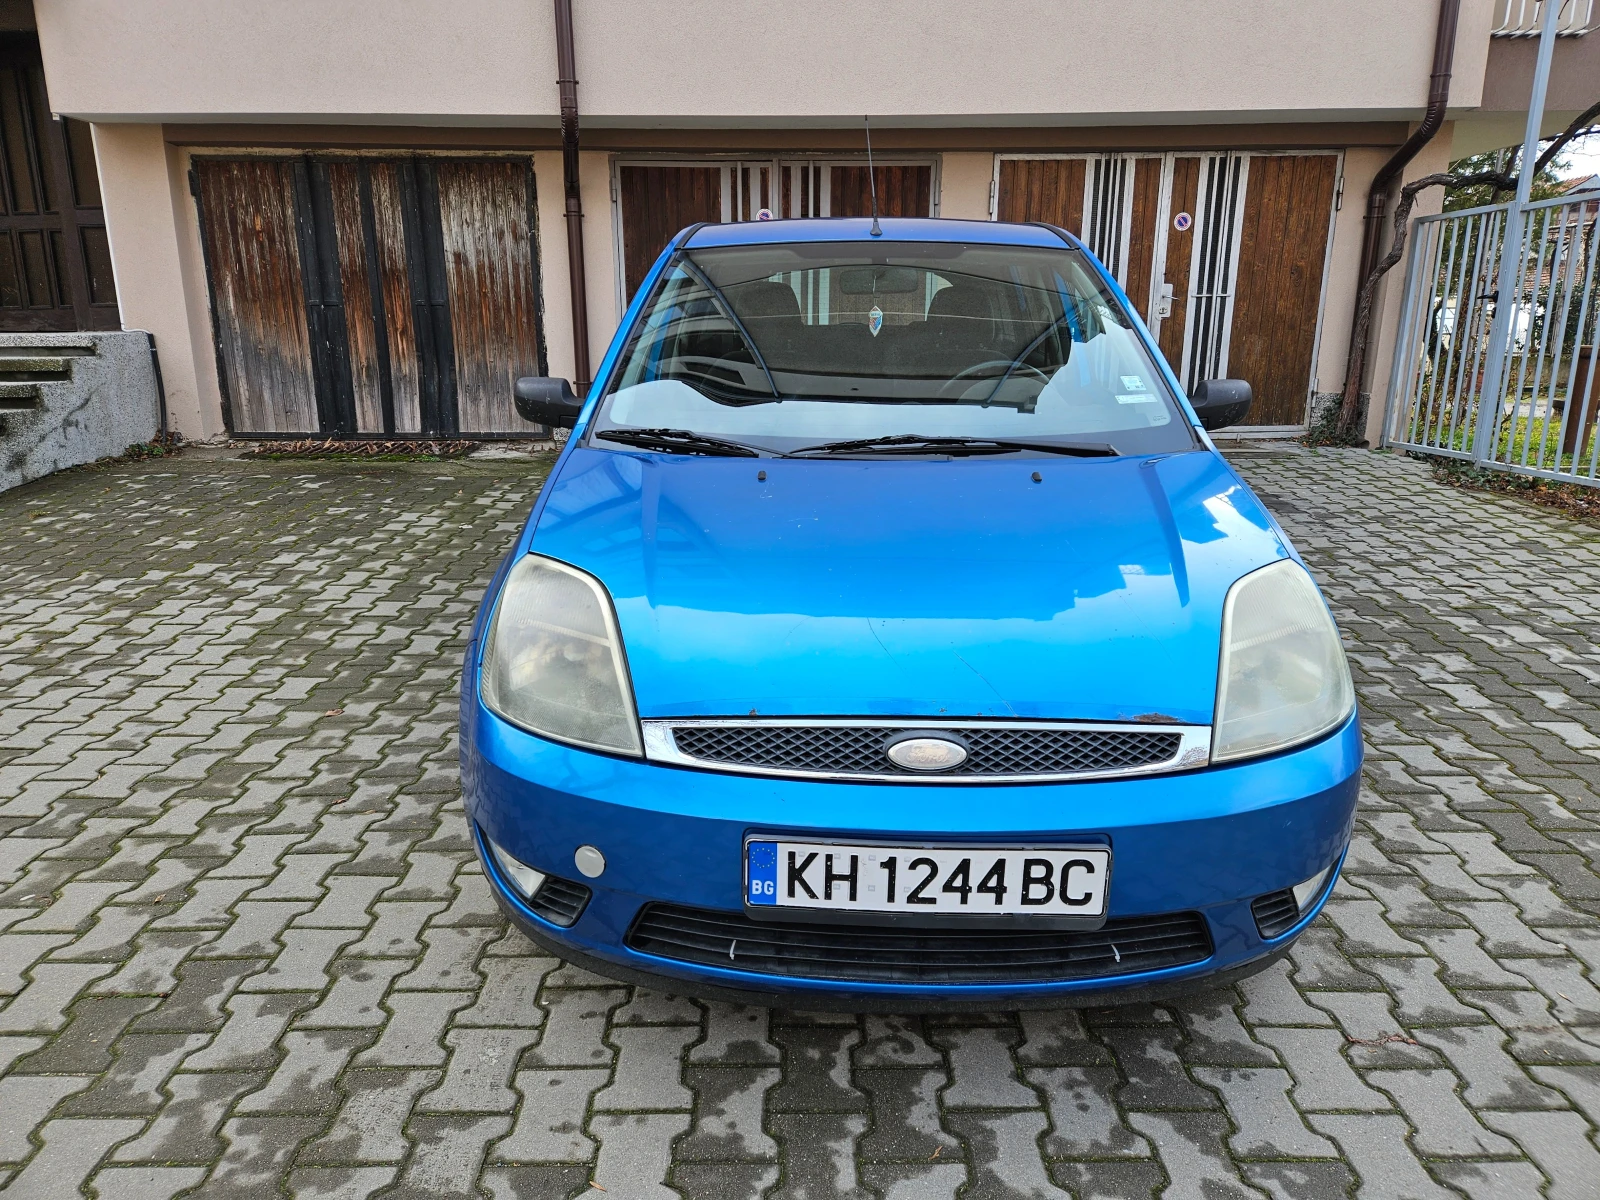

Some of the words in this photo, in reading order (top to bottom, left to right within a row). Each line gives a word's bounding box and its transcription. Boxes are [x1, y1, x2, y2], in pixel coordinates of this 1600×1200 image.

[751, 879, 775, 896] BG
[786, 850, 859, 902] KH
[879, 856, 1008, 906] 1244
[1020, 857, 1096, 907] BC
